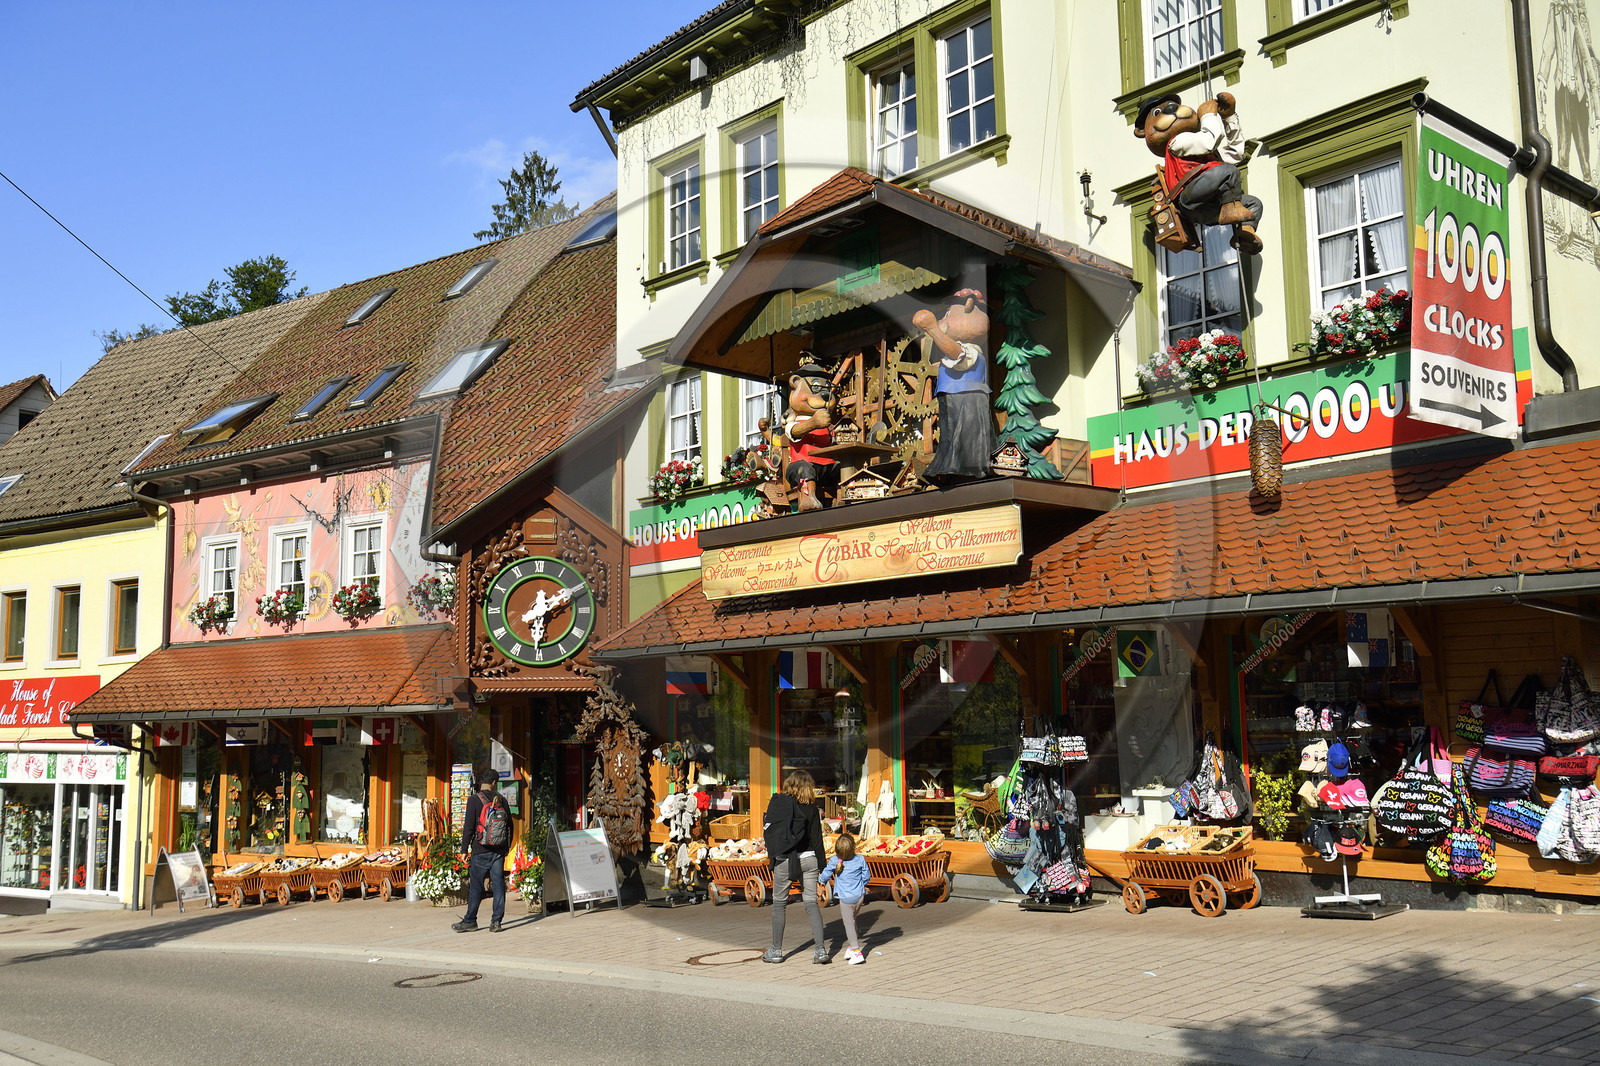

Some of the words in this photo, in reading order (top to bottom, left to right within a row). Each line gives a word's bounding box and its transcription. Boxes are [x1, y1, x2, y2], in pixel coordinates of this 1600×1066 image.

[1428, 148, 1503, 211] UHREN
[1424, 206, 1507, 300] 1000
[1424, 304, 1505, 350] CLOCKS
[1421, 362, 1507, 402] SOUVENIRS
[1114, 421, 1189, 465] HAUS
[1198, 411, 1254, 450] DER
[633, 518, 677, 548] HOUSE
[680, 515, 698, 540] OF
[900, 516, 952, 536] Welkom
[719, 545, 772, 563] Benvenuto
[875, 536, 931, 558] Herzlich
[936, 528, 1018, 550] Willkommen
[704, 564, 747, 581] Welcome
[757, 558, 803, 575] ウエルカム
[916, 551, 985, 571] Bienvenue
[743, 572, 797, 592] Bienvenido
[1084, 636, 1107, 661] 1000
[1268, 622, 1296, 651] 1000
[919, 648, 937, 671] 1000
[1244, 658, 1263, 674] HOUSE
[10, 679, 39, 702] House
[42, 678, 56, 708] of
[0, 704, 19, 725] lack
[22, 703, 53, 725] Forest
